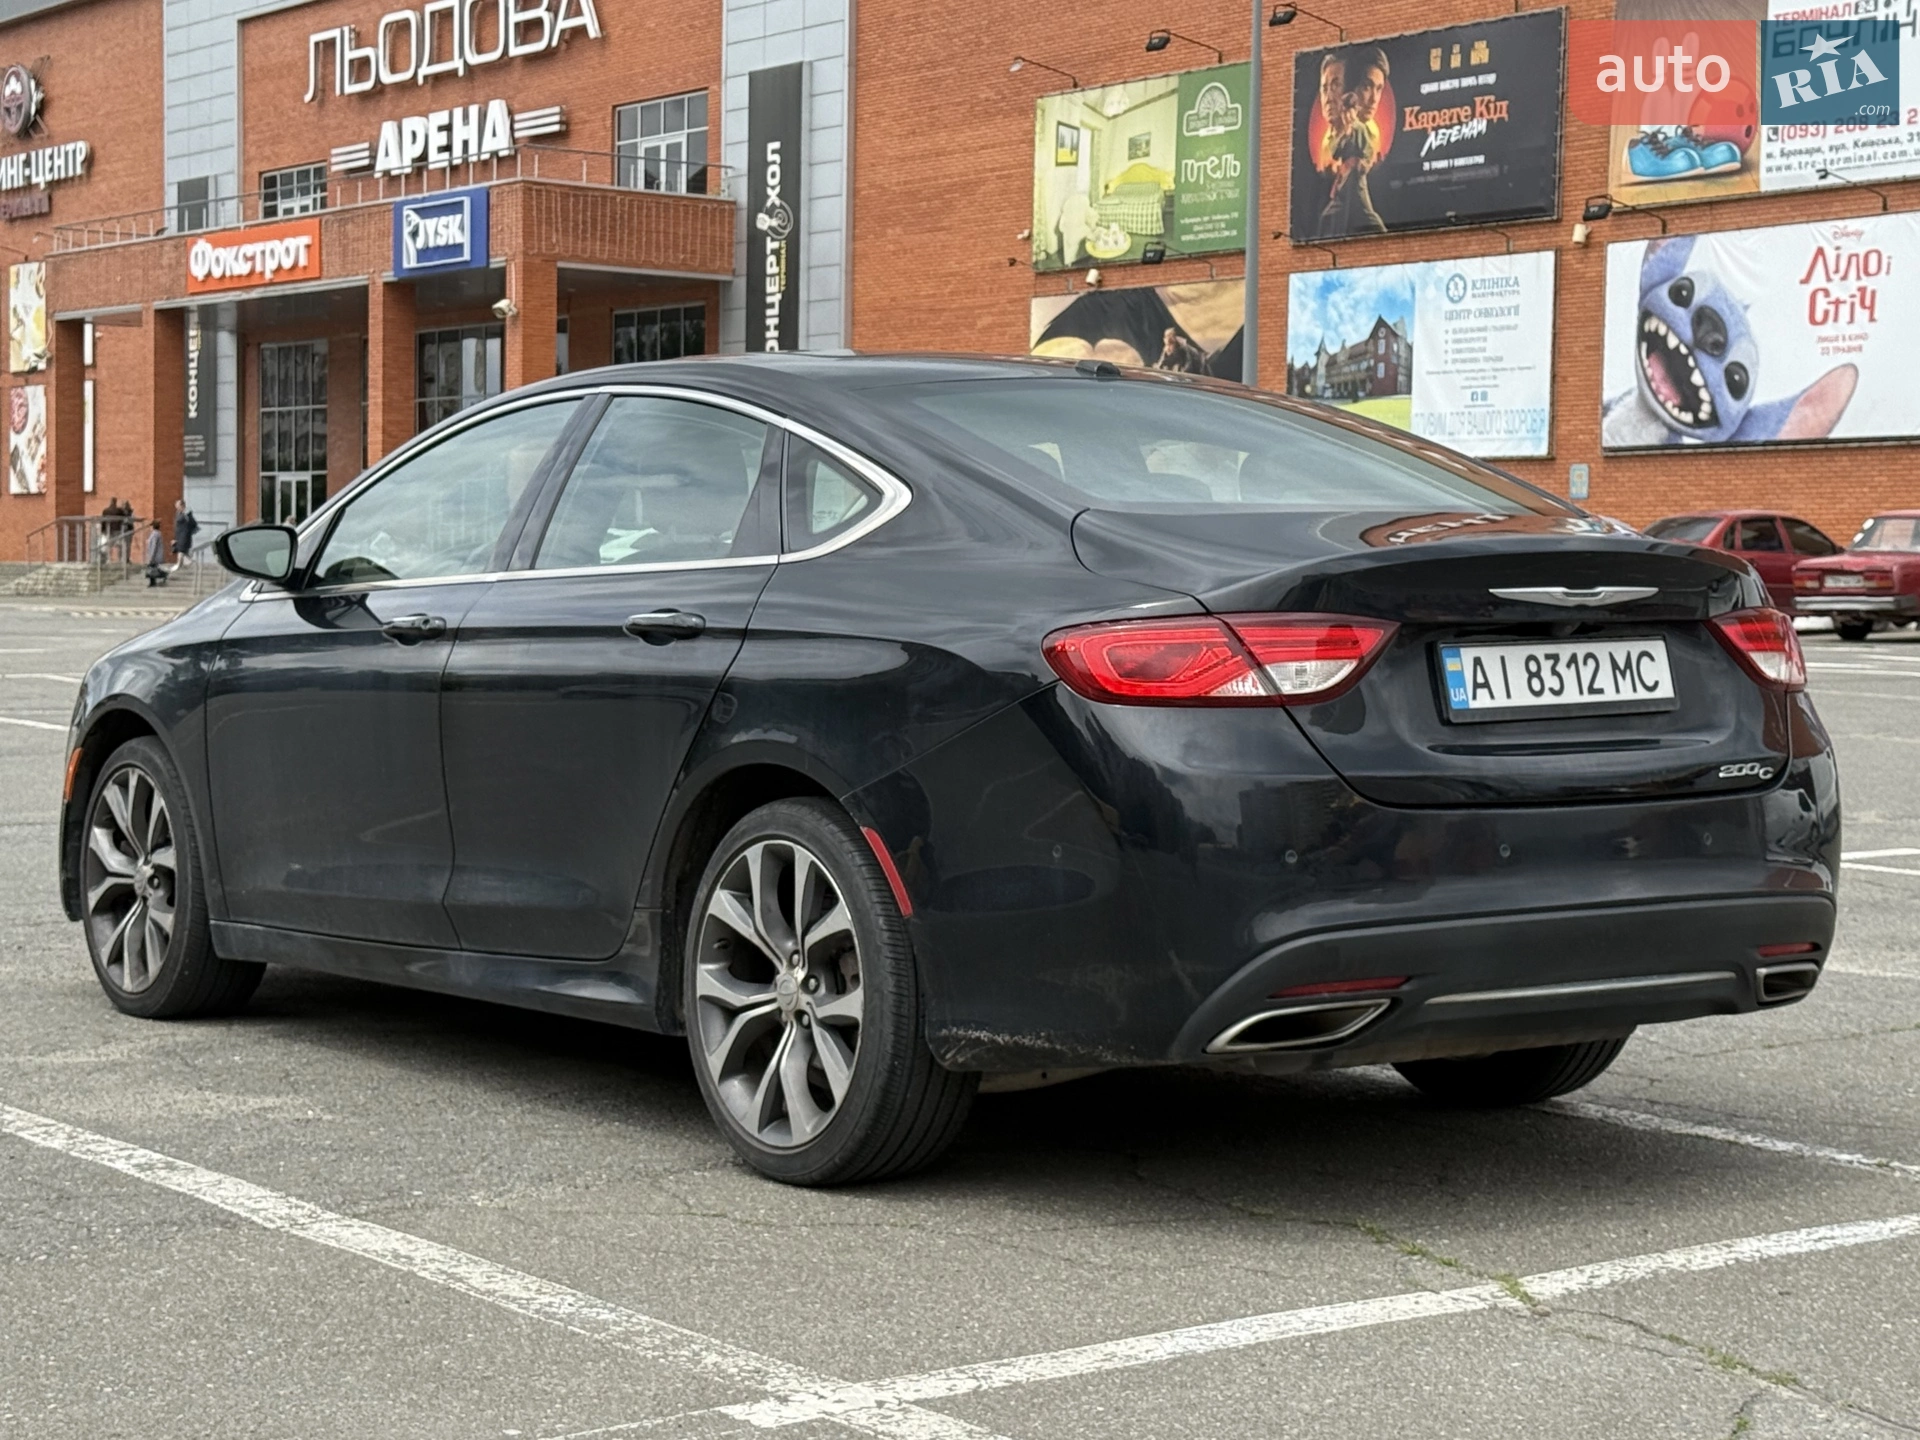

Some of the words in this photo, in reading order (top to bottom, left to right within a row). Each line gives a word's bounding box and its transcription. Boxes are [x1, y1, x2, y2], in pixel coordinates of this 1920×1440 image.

[1774, 2, 1852, 27] ТЕРМІНАЛ
[304, 0, 602, 103] ЛЬОДОВА
[1403, 105, 1472, 134] Карате
[1473, 95, 1509, 122] Кід
[1781, 120, 1827, 143] (093)
[1834, 115, 1869, 134] 208
[1876, 111, 1899, 129] 23
[374, 99, 512, 178] АРЕНА
[766, 141, 782, 208] ХОЛ
[415, 214, 466, 250] JYSK
[189, 235, 312, 281] Фокстрот
[1799, 245, 1883, 285] Ліло
[1471, 276, 1520, 291] КЛІНІКА
[1524, 651, 1605, 698] 8312
[1608, 650, 1660, 694] MC
[1450, 687, 1468, 702] UA
